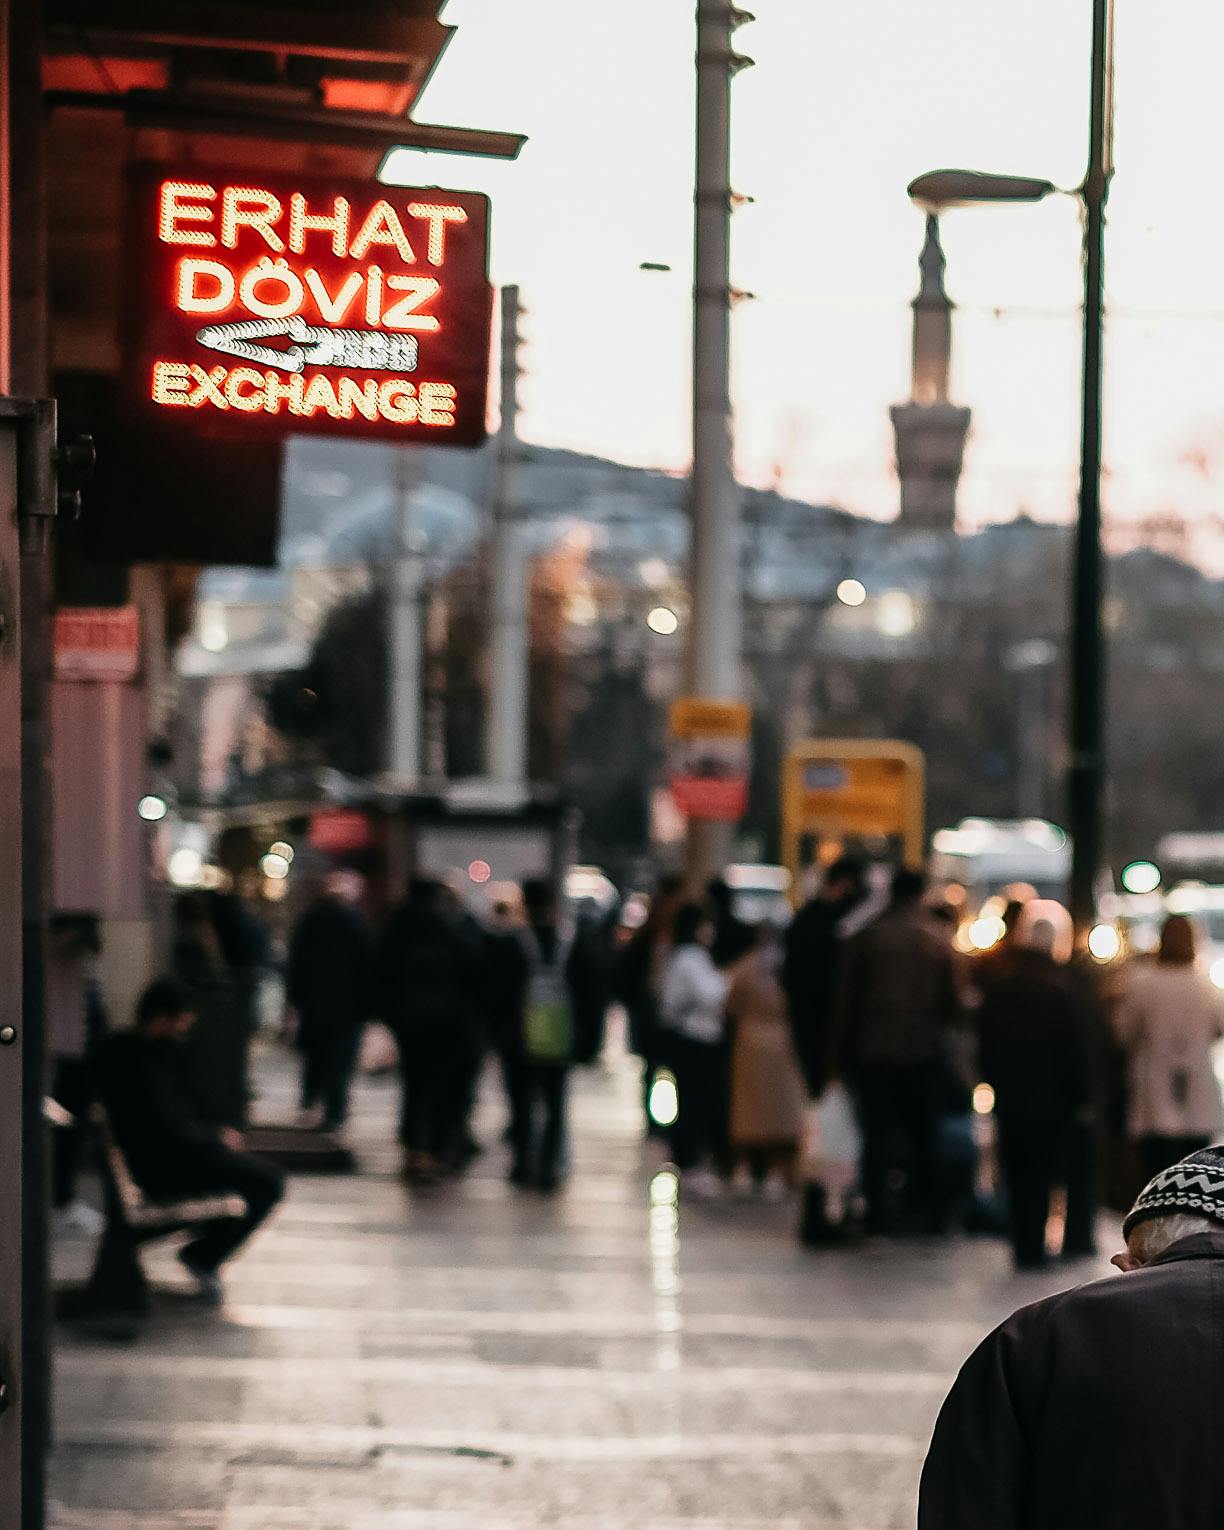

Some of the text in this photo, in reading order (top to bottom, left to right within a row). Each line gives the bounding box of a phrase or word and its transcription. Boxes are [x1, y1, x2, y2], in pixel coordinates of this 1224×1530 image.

[159, 181, 467, 266] ERHAT
[177, 256, 440, 331] DÖVİZ
[152, 361, 457, 426] EXCHANGE
